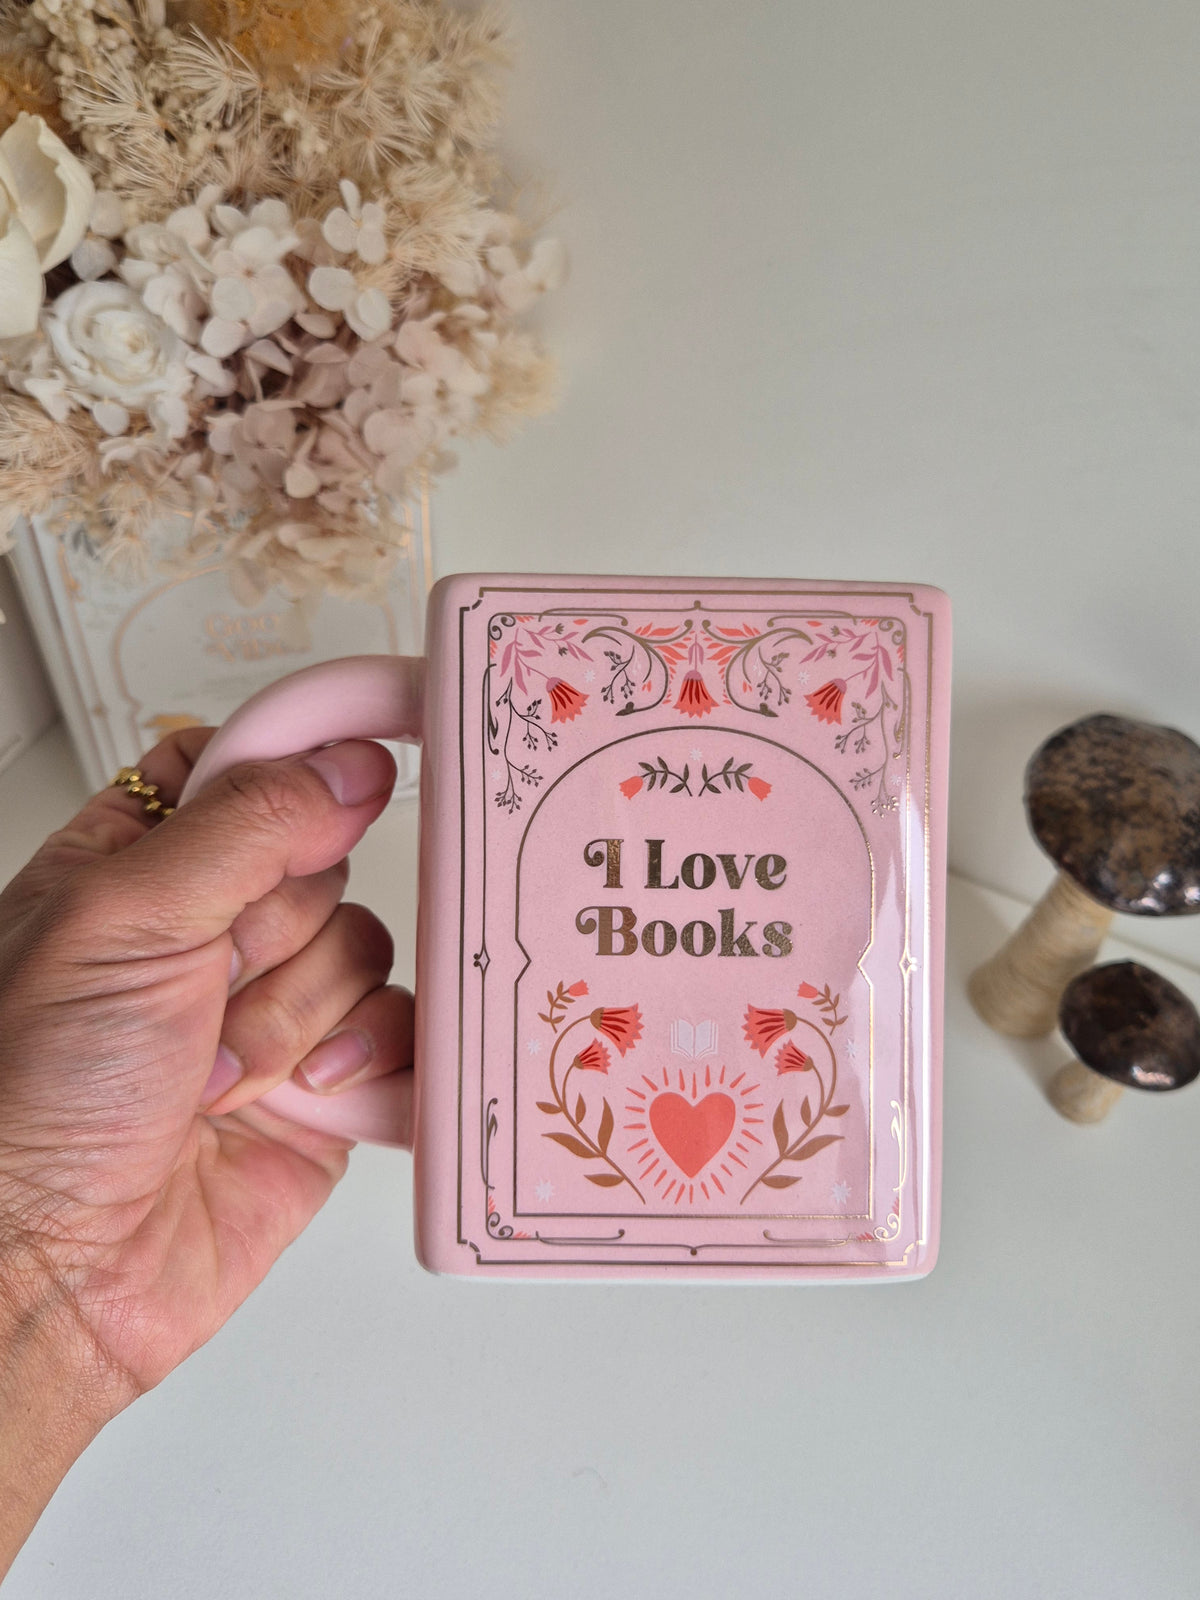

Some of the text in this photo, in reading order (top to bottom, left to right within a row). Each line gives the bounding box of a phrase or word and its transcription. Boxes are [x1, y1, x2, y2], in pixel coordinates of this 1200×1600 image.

[583, 838, 788, 891] I Love
[575, 905, 794, 958] Books
